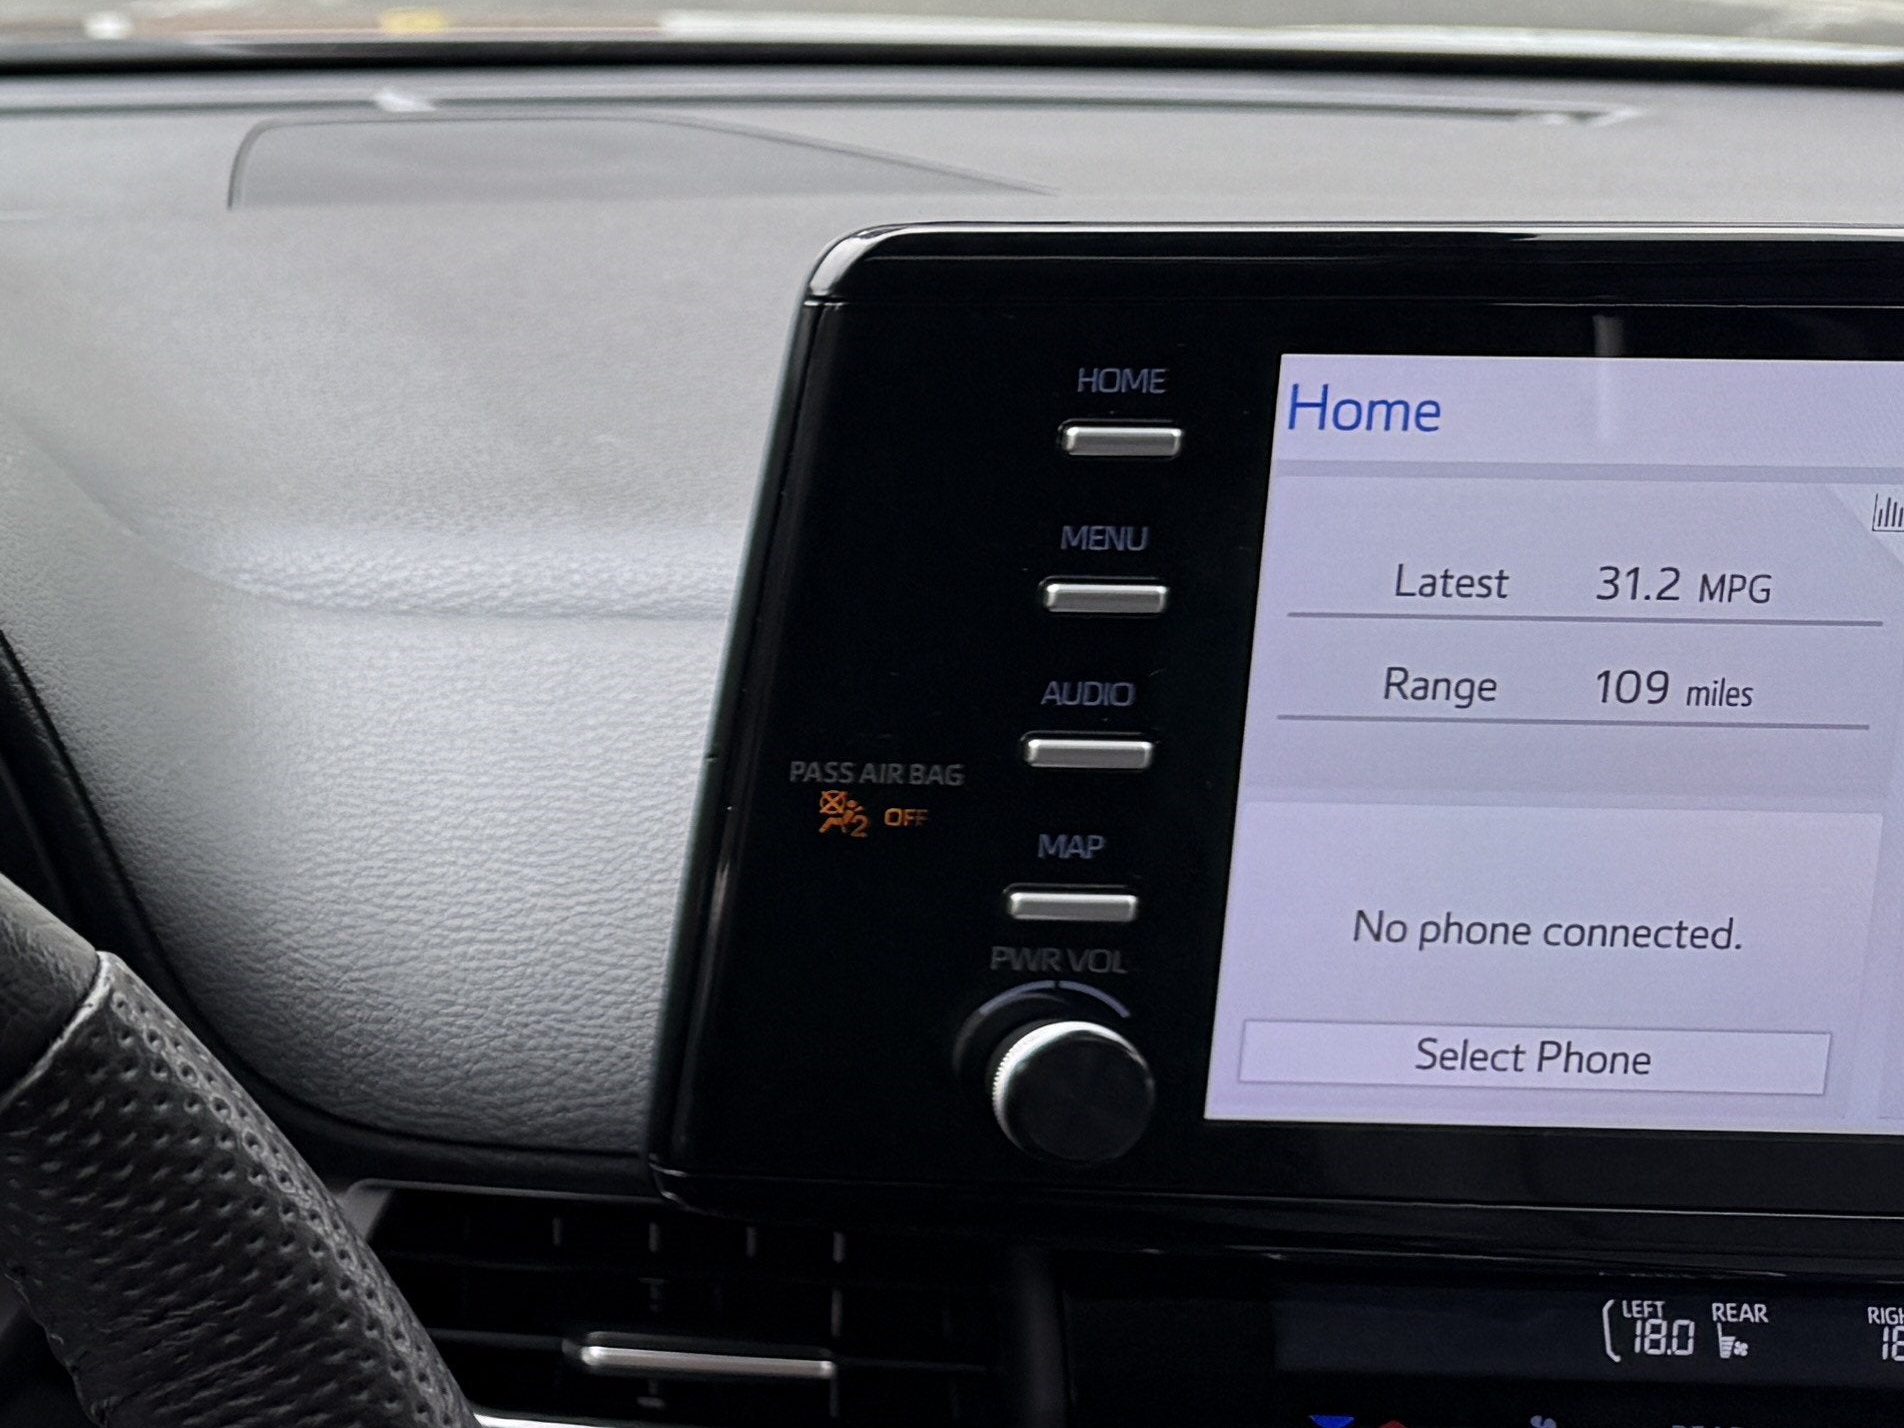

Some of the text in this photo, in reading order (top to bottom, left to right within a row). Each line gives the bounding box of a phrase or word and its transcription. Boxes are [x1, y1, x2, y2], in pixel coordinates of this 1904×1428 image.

[1077, 368, 1167, 394] HOME
[1288, 383, 1440, 432] Home
[1061, 525, 1148, 551] MENU
[1395, 564, 1771, 603] Latest 31.2 MPG
[1041, 681, 1135, 706] AUDIO
[1384, 667, 1753, 709] Range 109 miles
[790, 761, 965, 786] PASS AIR BAG
[884, 808, 928, 826] OFF
[1038, 834, 1106, 859] MAP
[1354, 910, 1741, 951] No phone connected.
[990, 946, 1128, 974] PWR VOL
[1415, 1037, 1651, 1075] Select Phone
[1621, 1299, 1667, 1319] LEFT
[1711, 1302, 1769, 1324] REAR
[1634, 1319, 1696, 1357] 18.0
